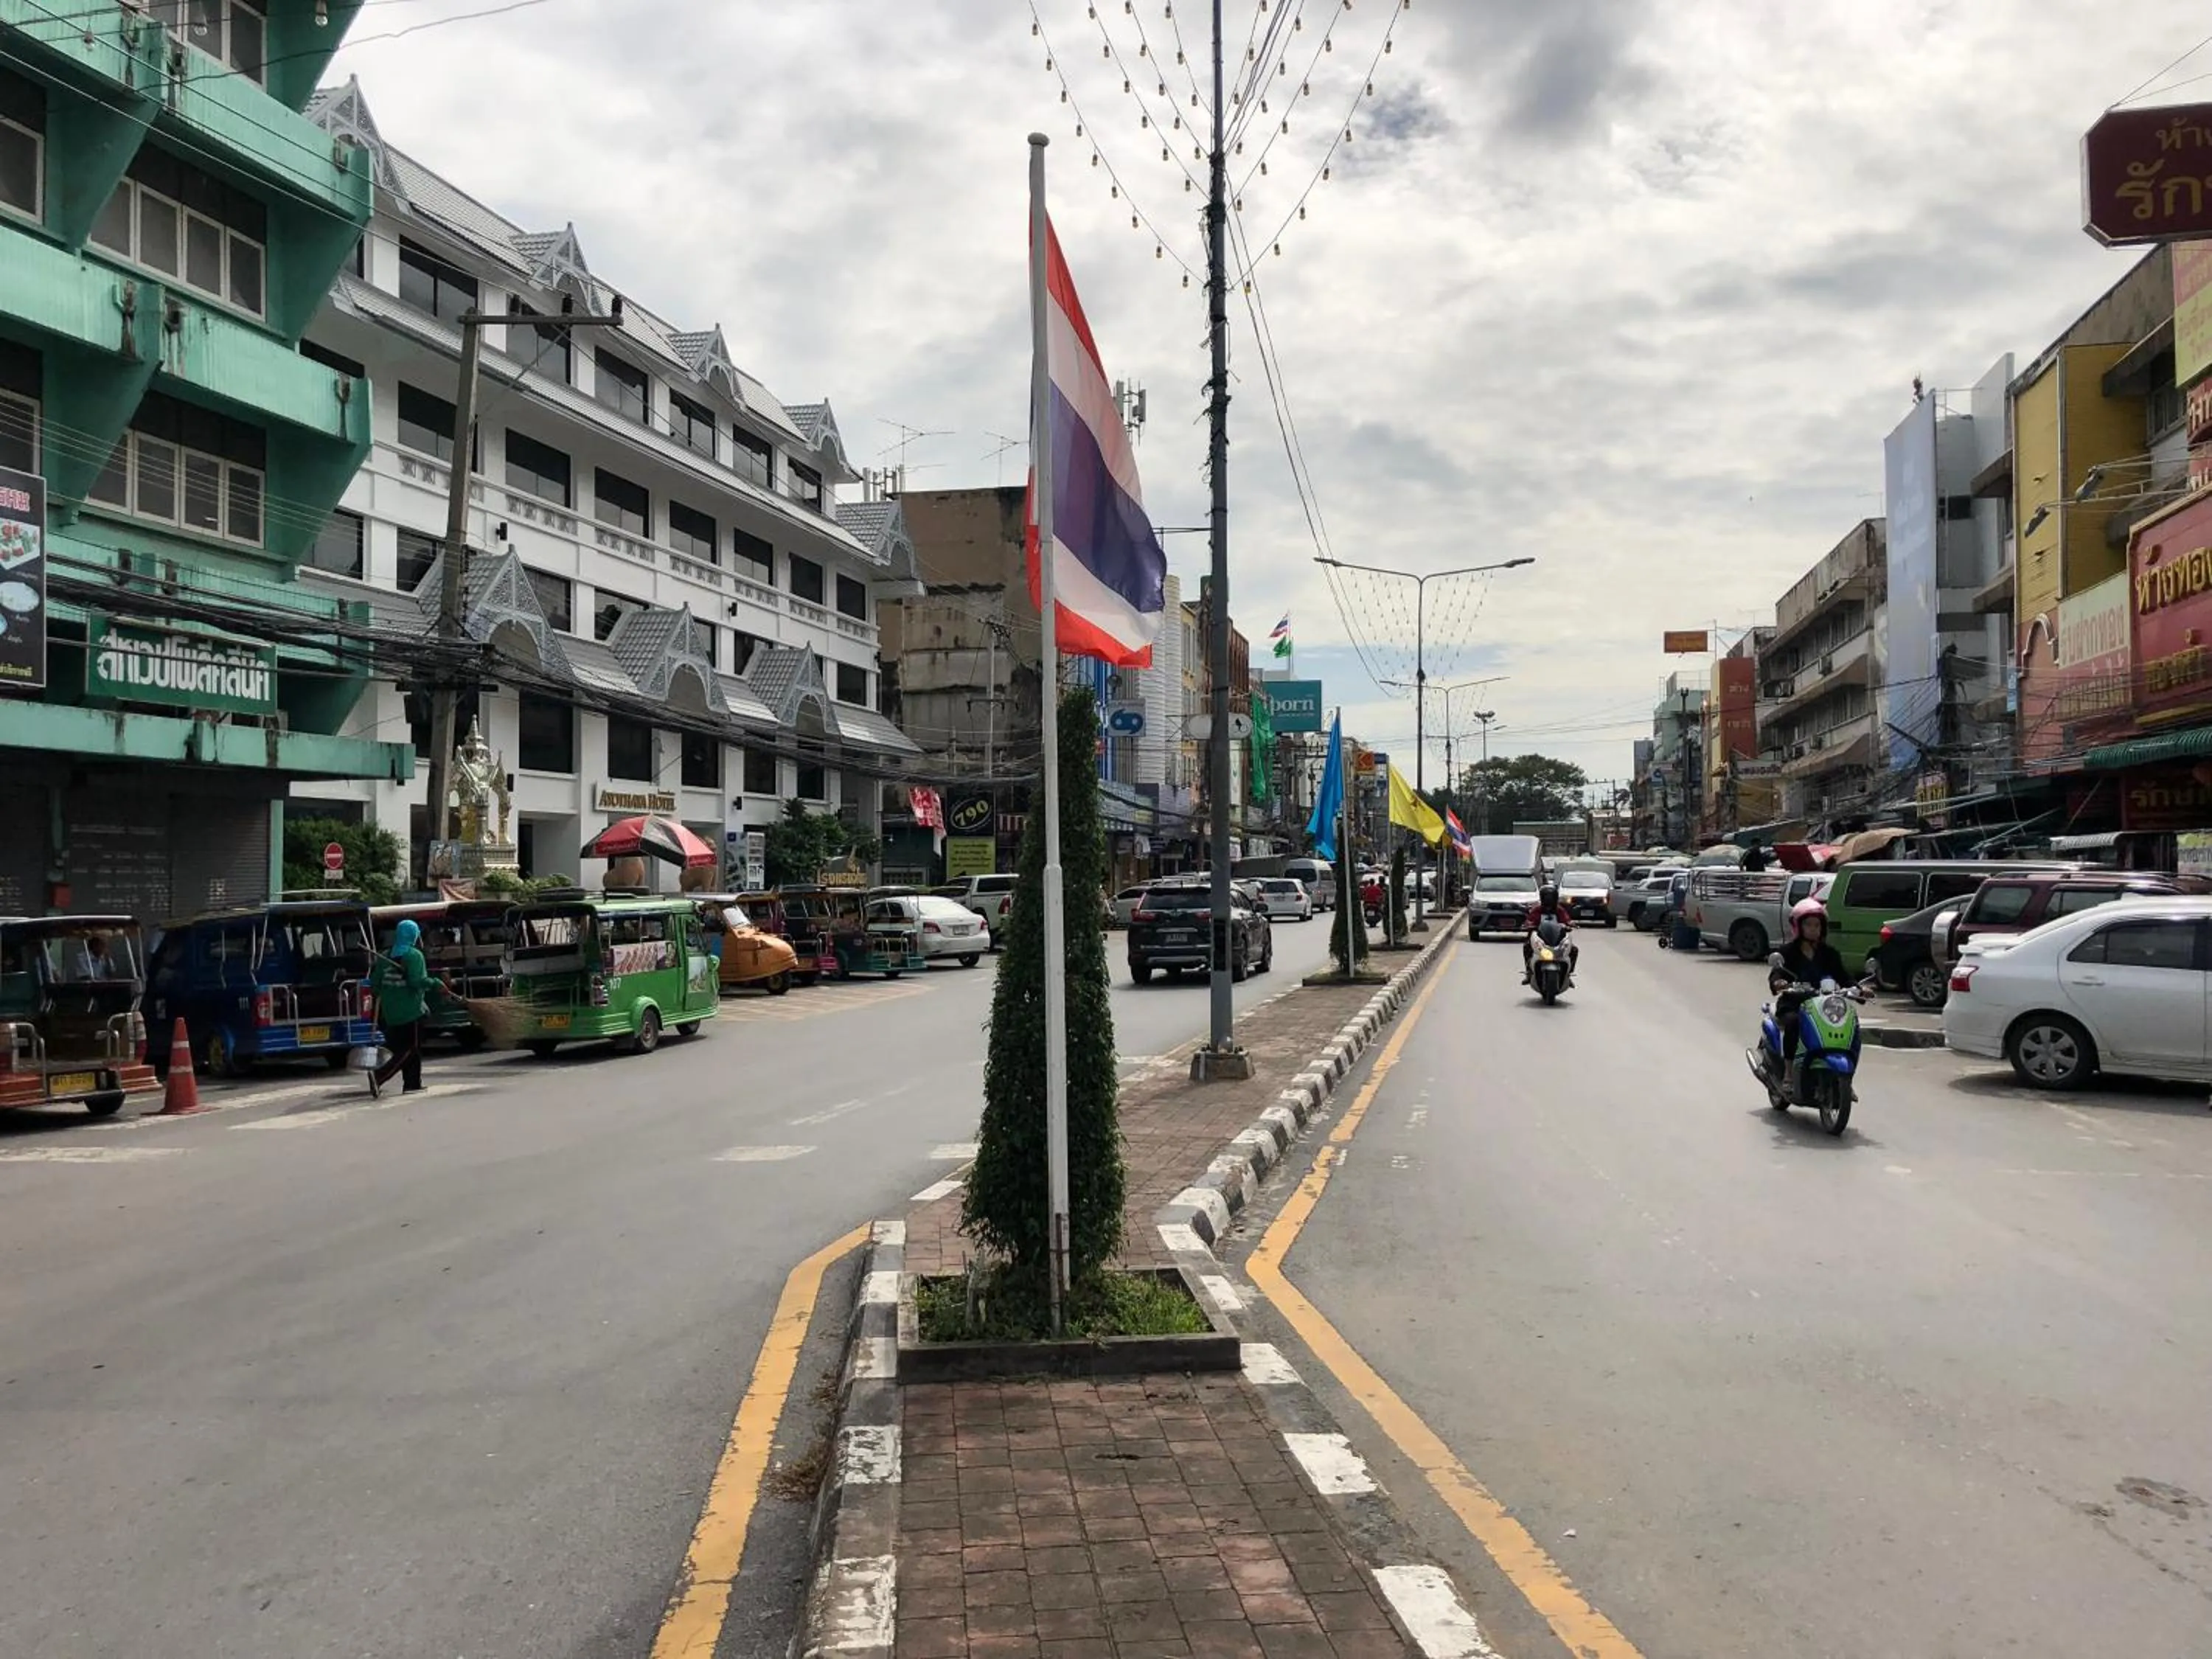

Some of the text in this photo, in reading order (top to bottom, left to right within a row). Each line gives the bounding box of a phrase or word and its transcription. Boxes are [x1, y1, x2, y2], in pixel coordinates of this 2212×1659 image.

[2115, 158, 2212, 220] รัก
[2135, 546, 2212, 614] ห้างทอ
[955, 800, 988, 826] 790
